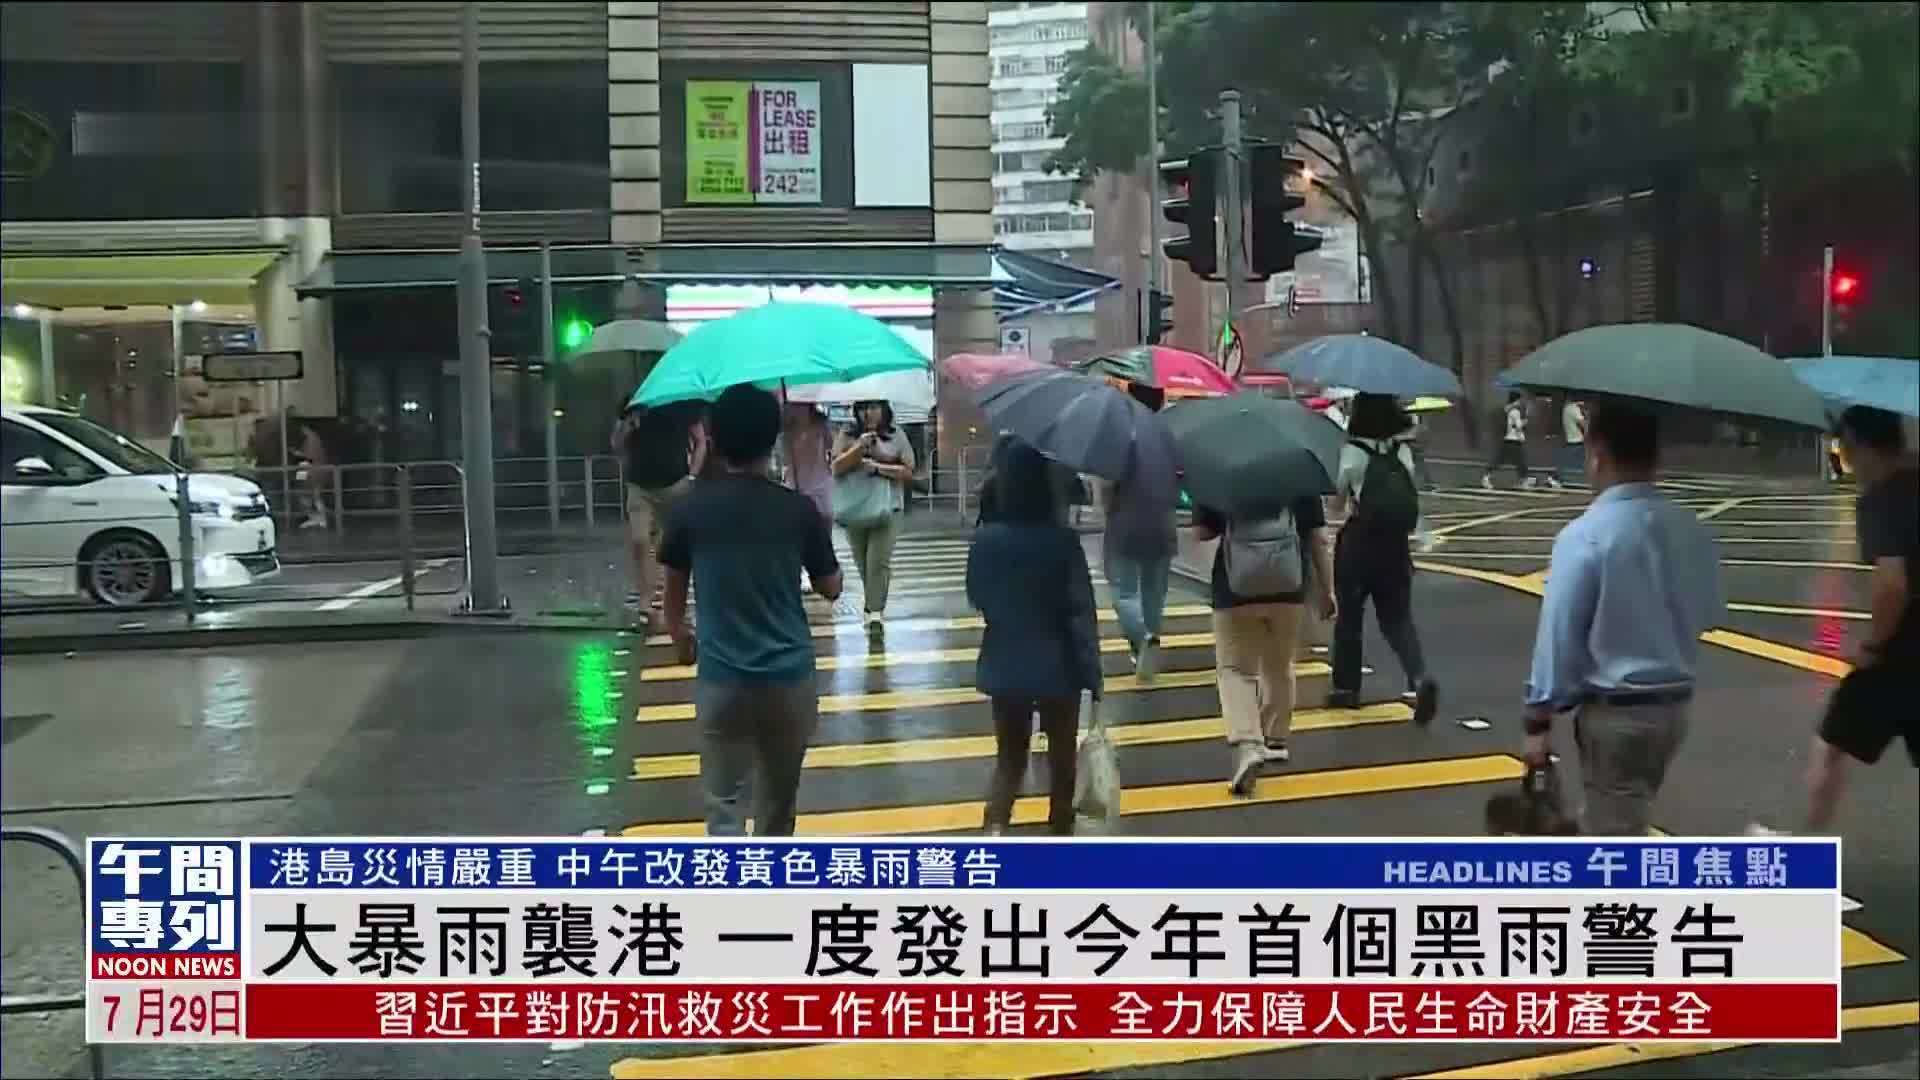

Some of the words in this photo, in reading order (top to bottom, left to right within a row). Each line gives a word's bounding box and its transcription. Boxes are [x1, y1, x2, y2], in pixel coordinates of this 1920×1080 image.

[763, 90, 797, 108] FOR
[763, 110, 817, 128] LEASE
[764, 129, 810, 154] 出租
